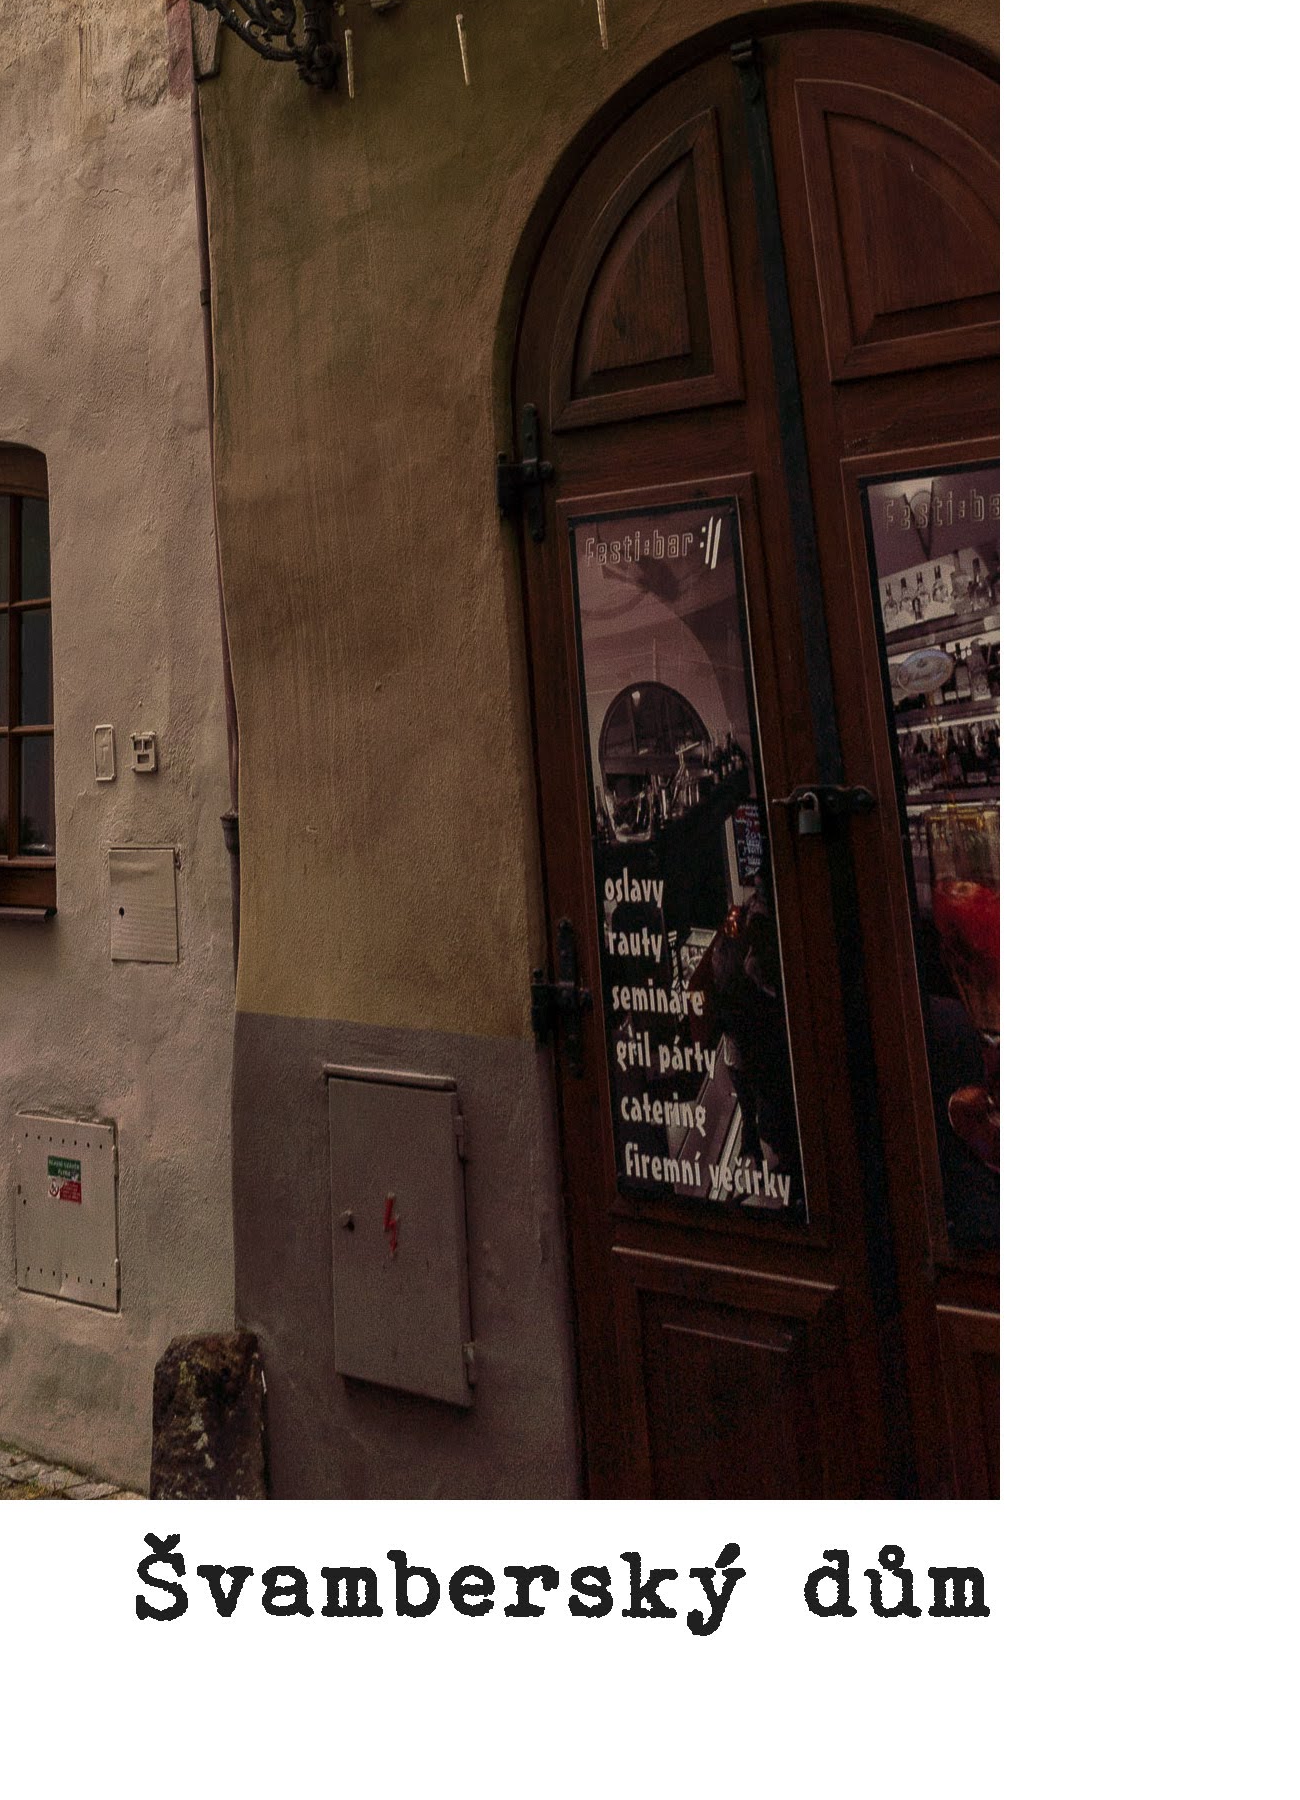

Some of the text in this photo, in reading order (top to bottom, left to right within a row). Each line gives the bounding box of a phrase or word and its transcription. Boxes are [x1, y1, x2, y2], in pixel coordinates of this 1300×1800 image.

[604, 867, 664, 908] oslavy
[608, 927, 663, 963] rauty
[612, 978, 704, 1016] semináře
[616, 1030, 716, 1080] gril párty
[621, 1092, 707, 1137] catering
[625, 1141, 791, 1206] firemní večírky
